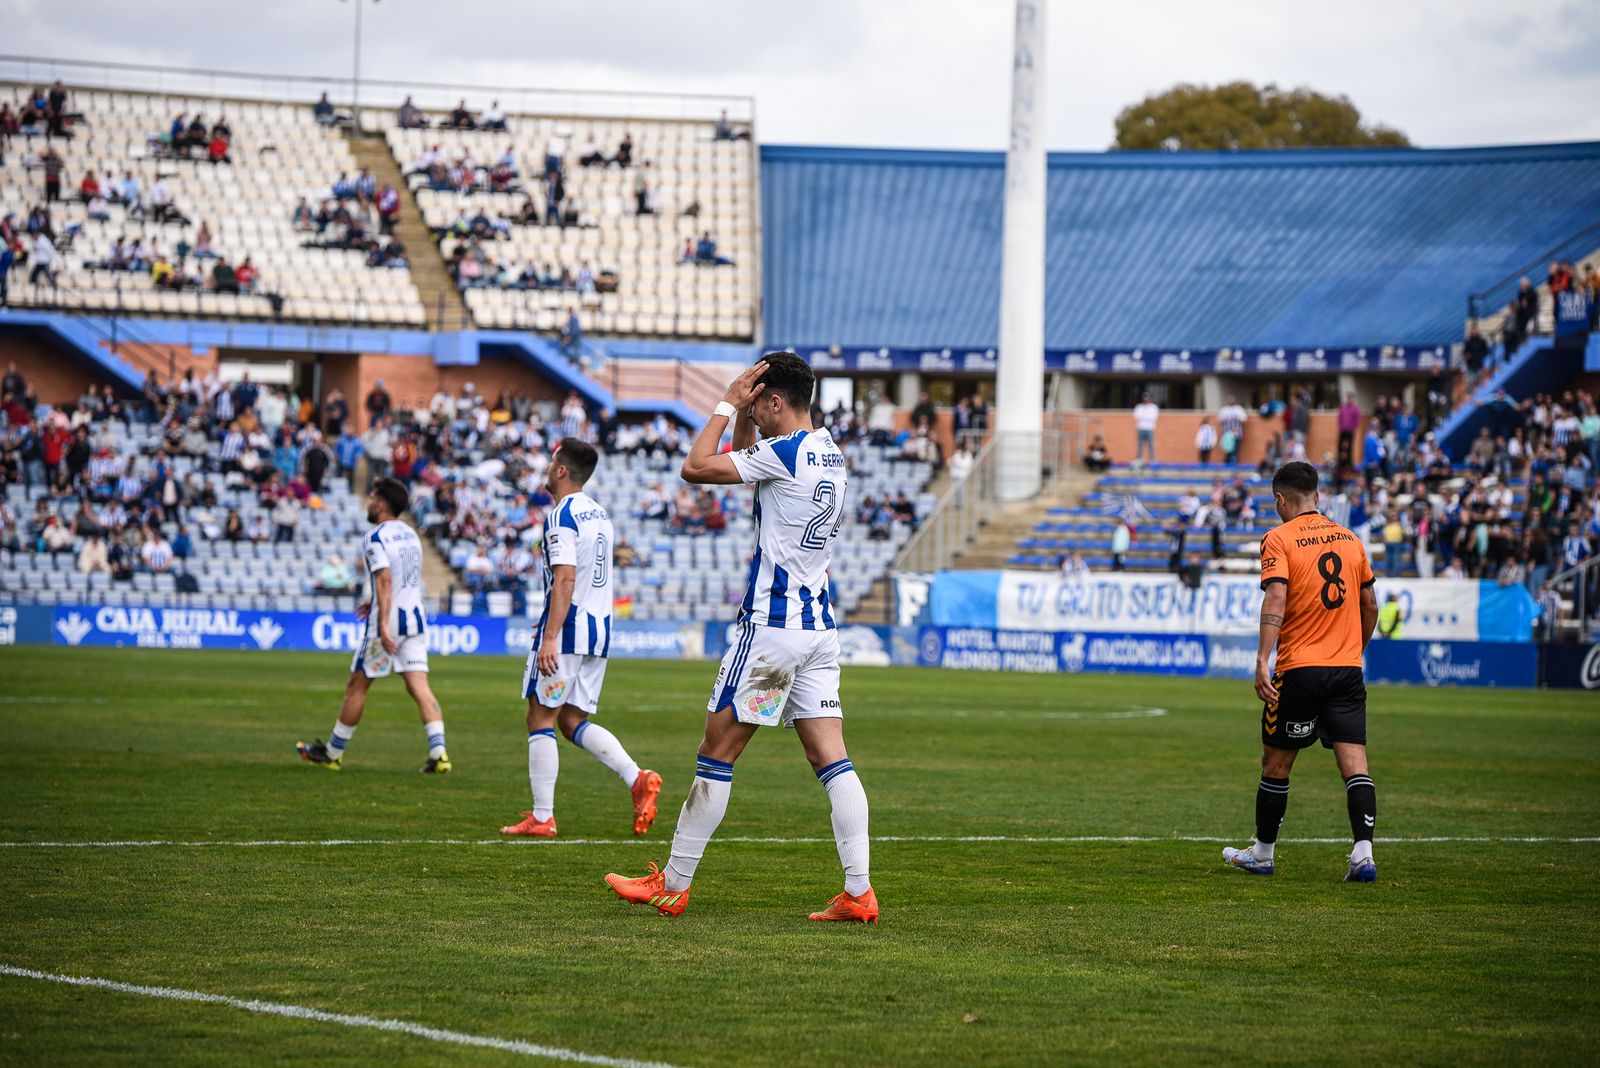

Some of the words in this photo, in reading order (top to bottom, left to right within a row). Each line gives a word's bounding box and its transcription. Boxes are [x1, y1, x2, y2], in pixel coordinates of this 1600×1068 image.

[806, 451, 819, 466] R.
[1296, 537, 1319, 547] TOMI
[592, 532, 608, 588] 9
[1318, 551, 1345, 610] 8
[1017, 582, 1047, 615] TU
[96, 606, 156, 634] CAJA
[161, 608, 246, 636] RURAL
[312, 614, 480, 656] Crumpo
